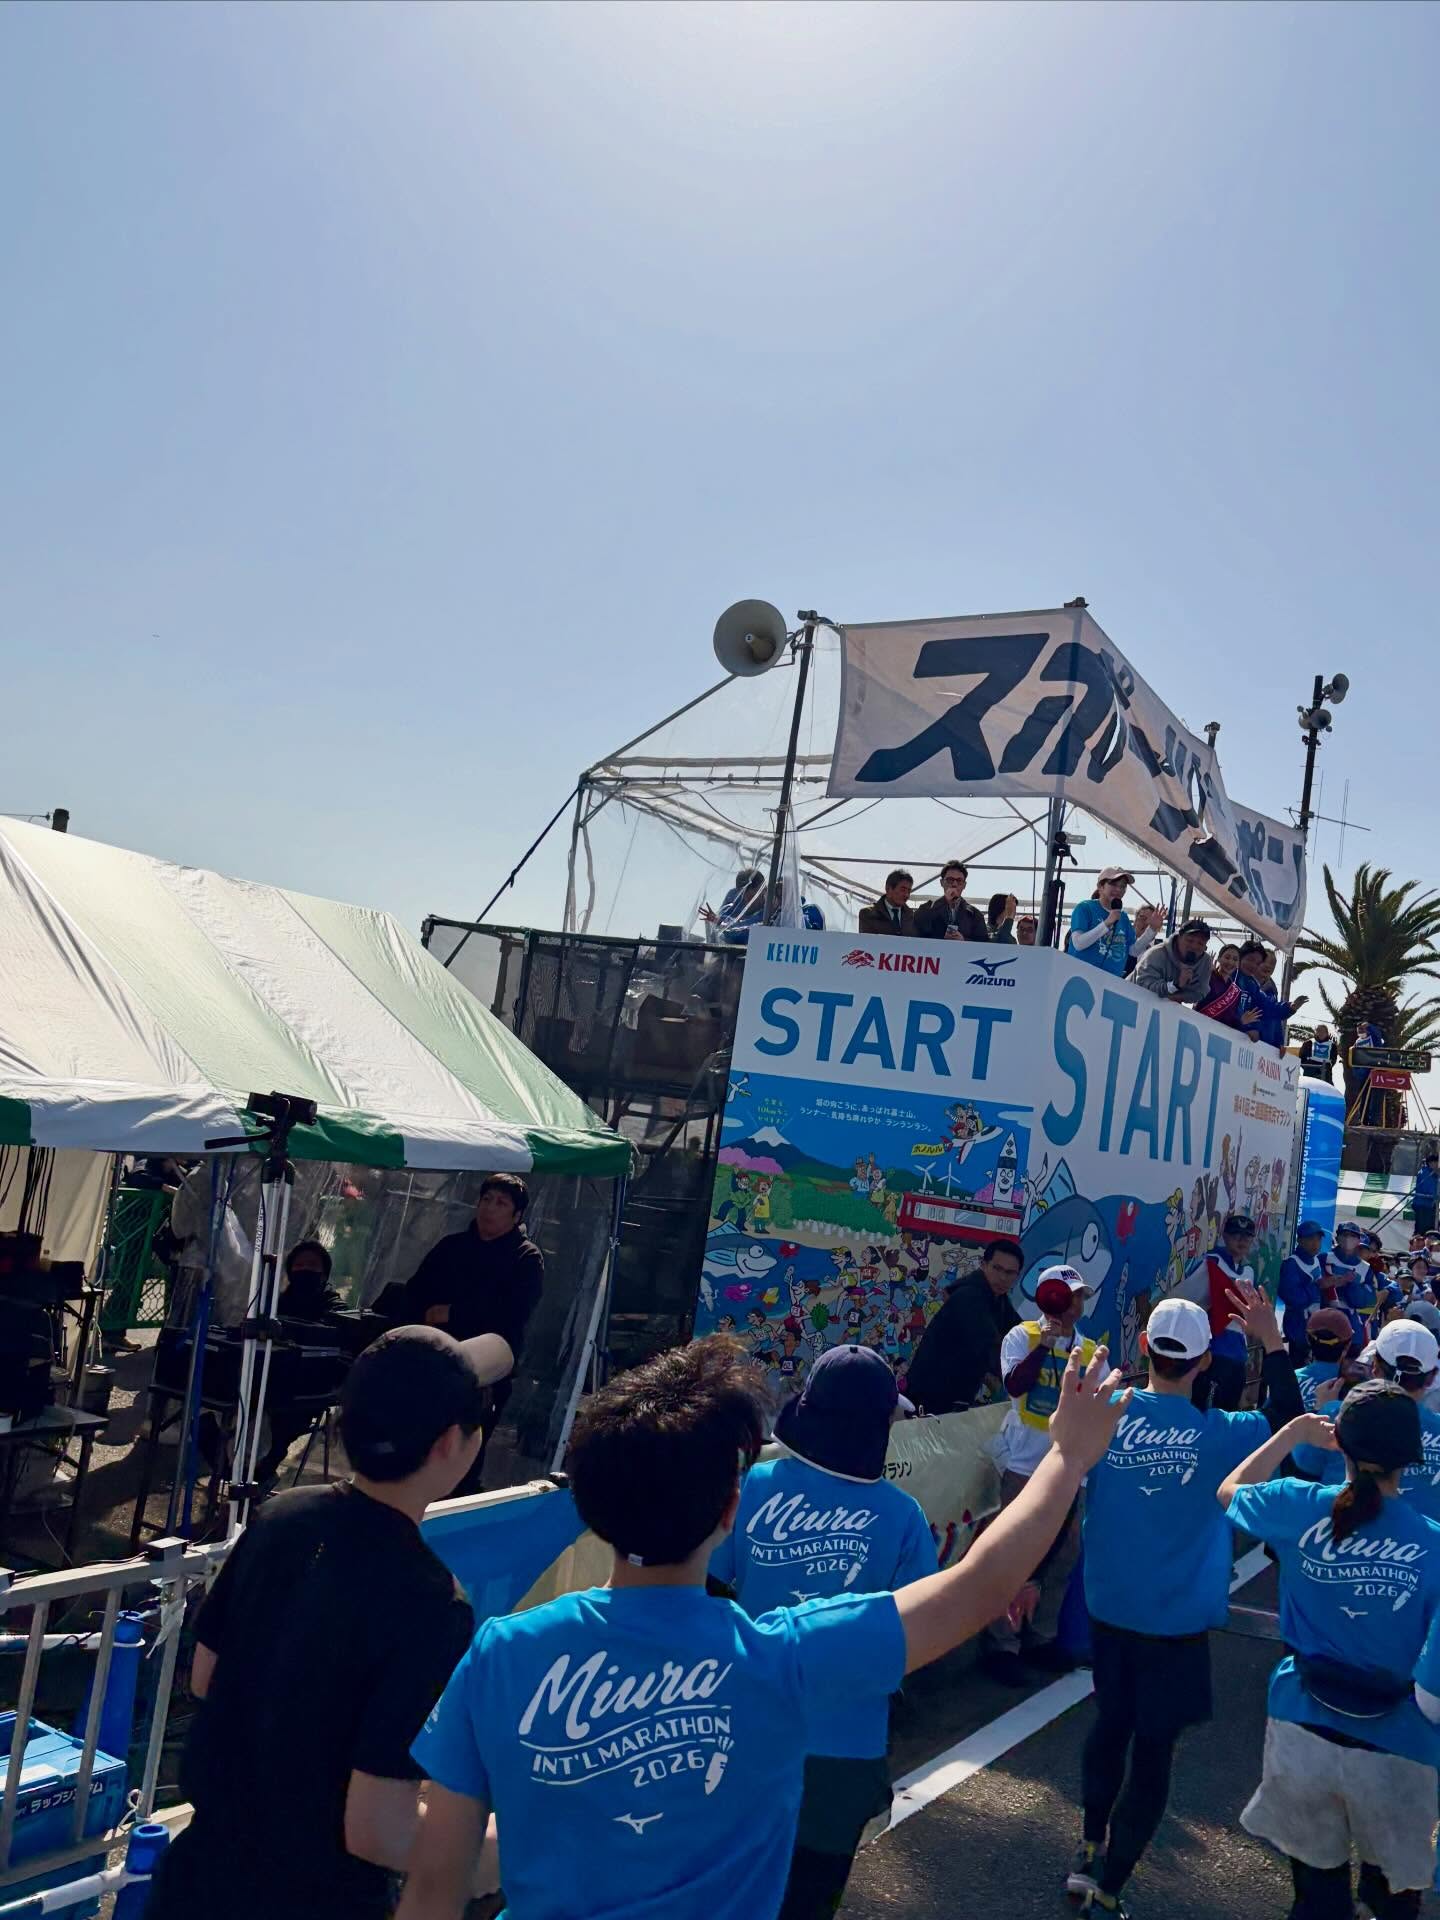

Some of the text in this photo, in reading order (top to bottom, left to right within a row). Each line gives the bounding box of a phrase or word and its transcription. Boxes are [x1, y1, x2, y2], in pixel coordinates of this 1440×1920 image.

[766, 943, 819, 966] KEIKYU
[878, 953, 941, 975] KIRIN
[754, 987, 1012, 1080] START
[1041, 975, 1232, 1168] START
[1375, 1074, 1406, 1085] ハーフ
[1305, 1107, 1315, 1142] Miura
[1116, 1414, 1203, 1451] Miura
[1107, 1451, 1198, 1465] INT'L MARATHON
[1149, 1464, 1184, 1477] 2026
[746, 1491, 880, 1541] Miura
[751, 1538, 869, 1562] INT'L MARATHON
[1298, 1516, 1429, 1562] Miura
[805, 1558, 849, 1576] 2026
[1302, 1559, 1419, 1584] INT'L MARATHON
[1353, 1584, 1398, 1597] 2026
[518, 1650, 733, 1739] Miura
[532, 1715, 732, 1776] INT'L MARATHON
[629, 1749, 706, 1788] 2026
[31, 1781, 104, 1814] ラップシム
